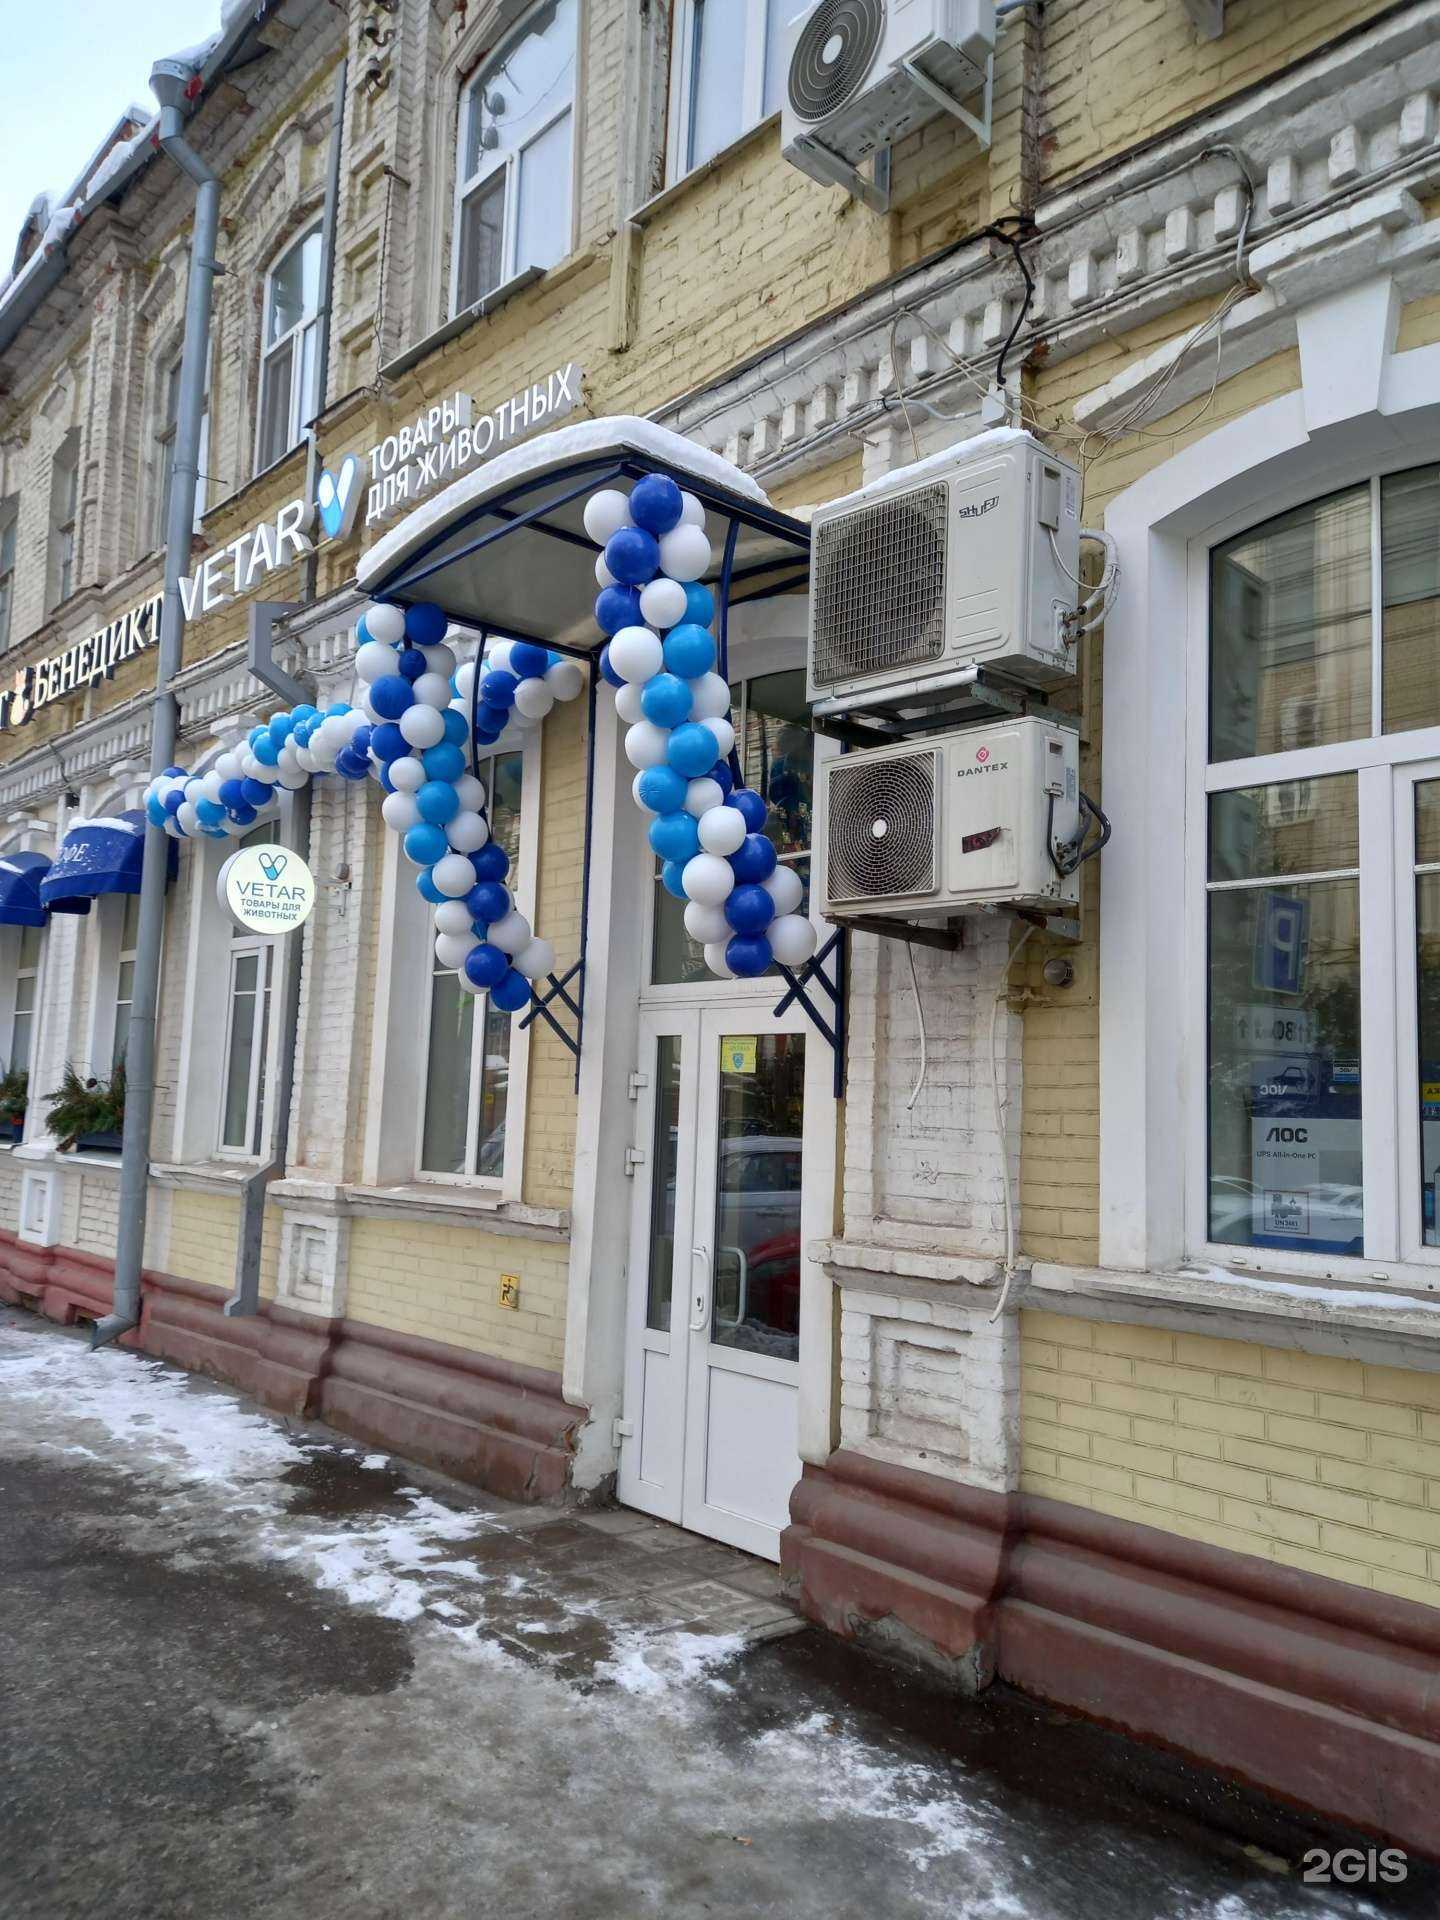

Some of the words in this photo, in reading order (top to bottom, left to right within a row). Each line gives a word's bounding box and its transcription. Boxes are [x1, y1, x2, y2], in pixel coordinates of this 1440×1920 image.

[365, 464, 410, 527] ДЛЯ
[416, 362, 573, 491] ЖИВОТНЫХ
[367, 391, 462, 480] ТОВАРЫ
[178, 499, 305, 621] VETAR
[33, 591, 165, 709] БЕНЕДИКТ
[957, 762, 1008, 777] DANTEX
[236, 880, 306, 902] VETAR
[240, 898, 280, 911] ТОВАРЫ
[281, 902, 301, 912] ДЛЯ
[243, 908, 298, 921] ЖИВОТНЫХ
[1264, 1127, 1309, 1143] AOC
